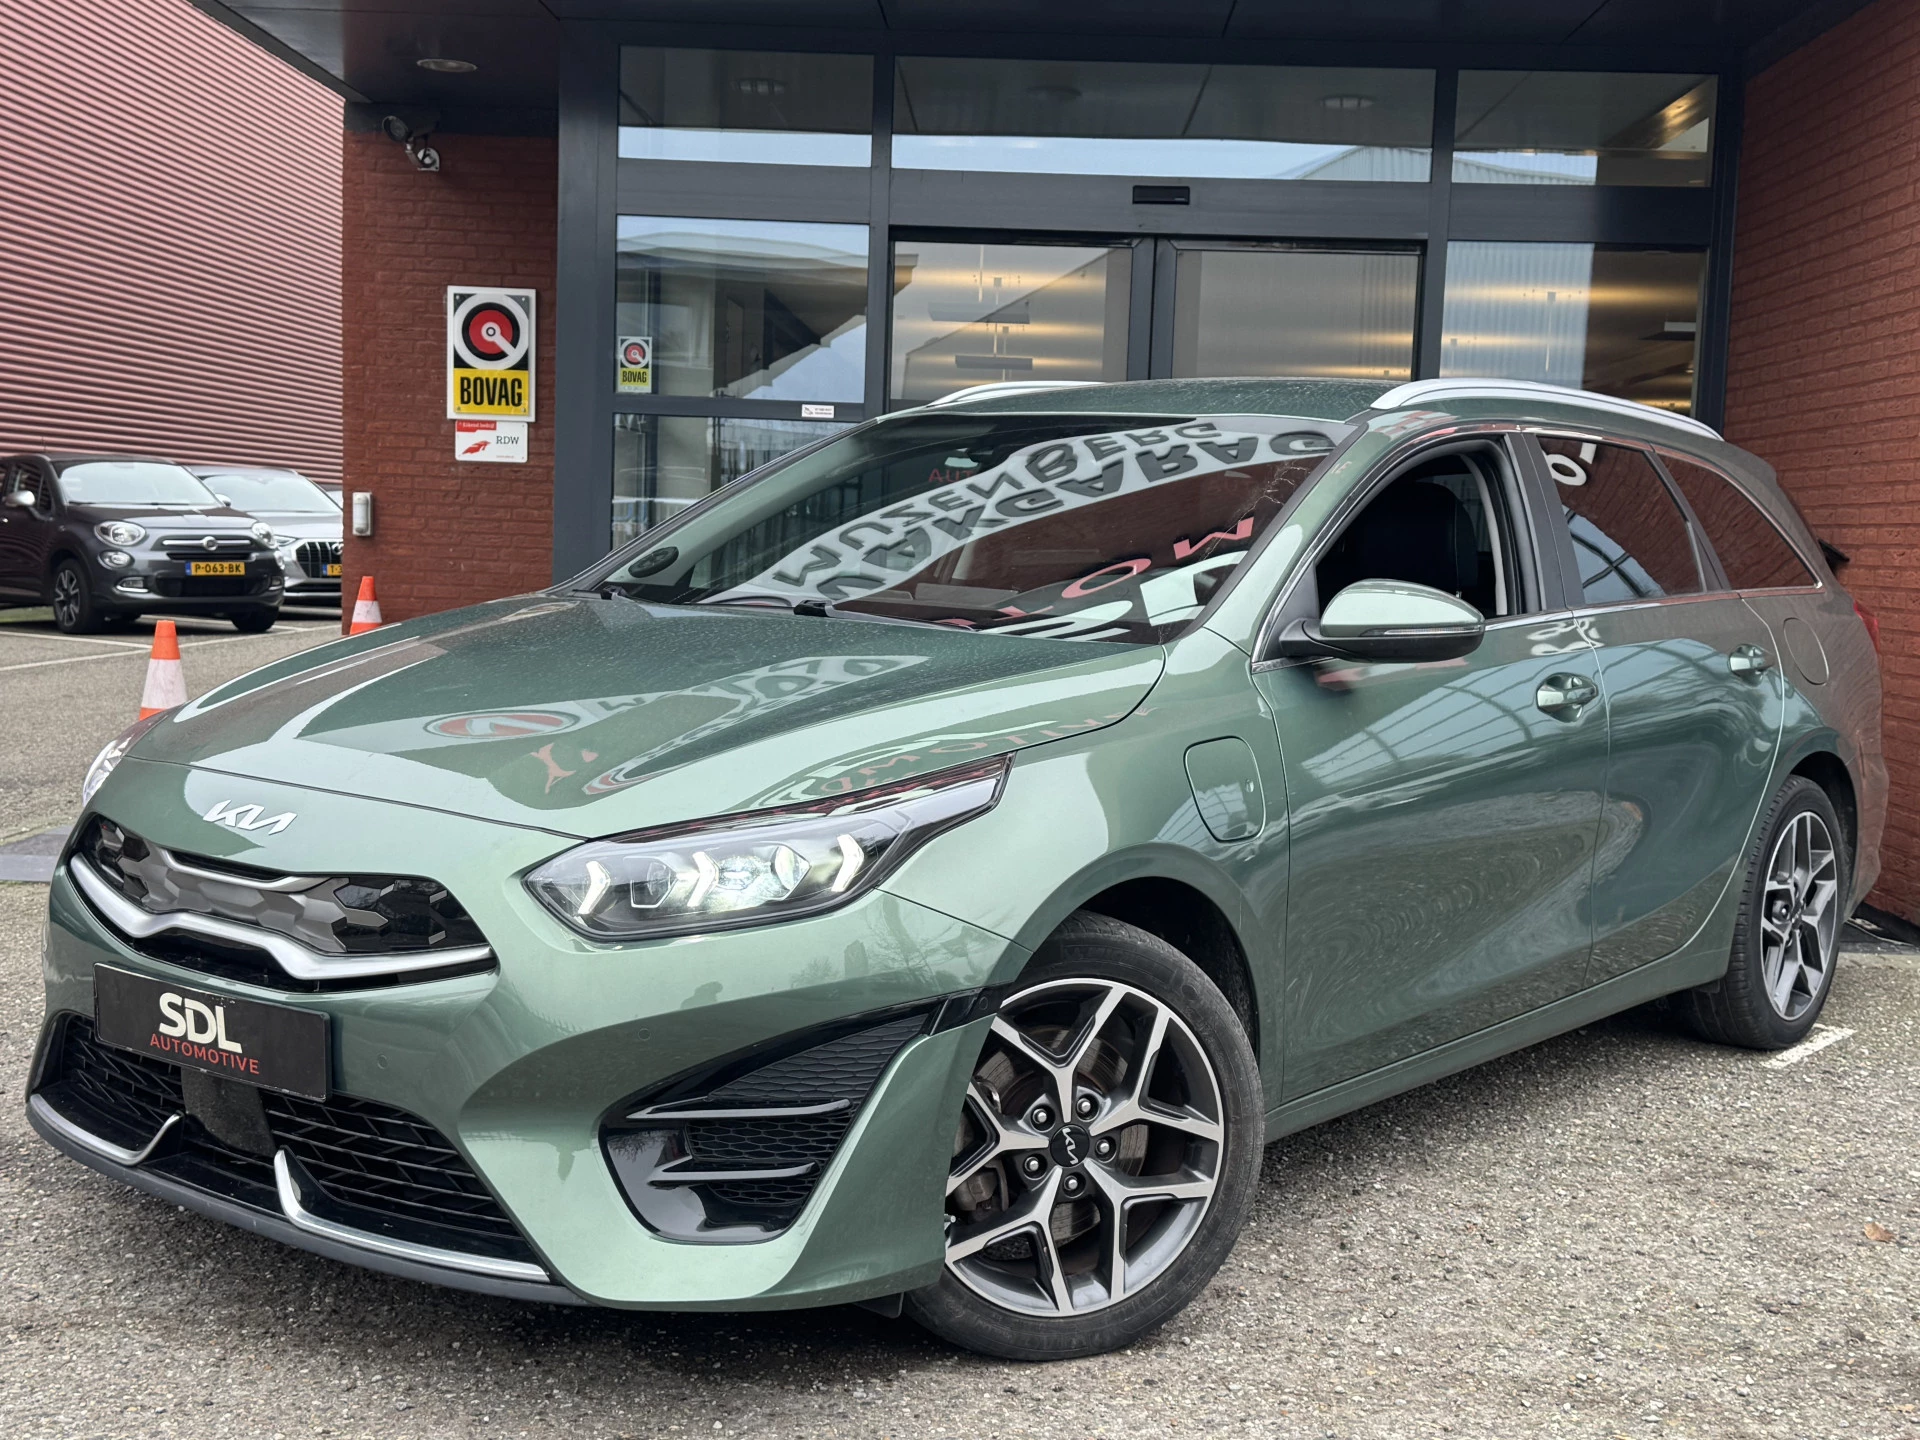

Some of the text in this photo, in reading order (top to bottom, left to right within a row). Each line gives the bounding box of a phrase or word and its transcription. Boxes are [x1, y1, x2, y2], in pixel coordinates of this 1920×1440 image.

[460, 376, 523, 408] BOVAG
[622, 370, 647, 383] BOVAG
[495, 436, 520, 445] RDW
[194, 561, 241, 574] P-063-BK
[203, 799, 298, 836] KIA
[159, 992, 242, 1054] SDL
[150, 1033, 260, 1075] AUTOMOTIVE
